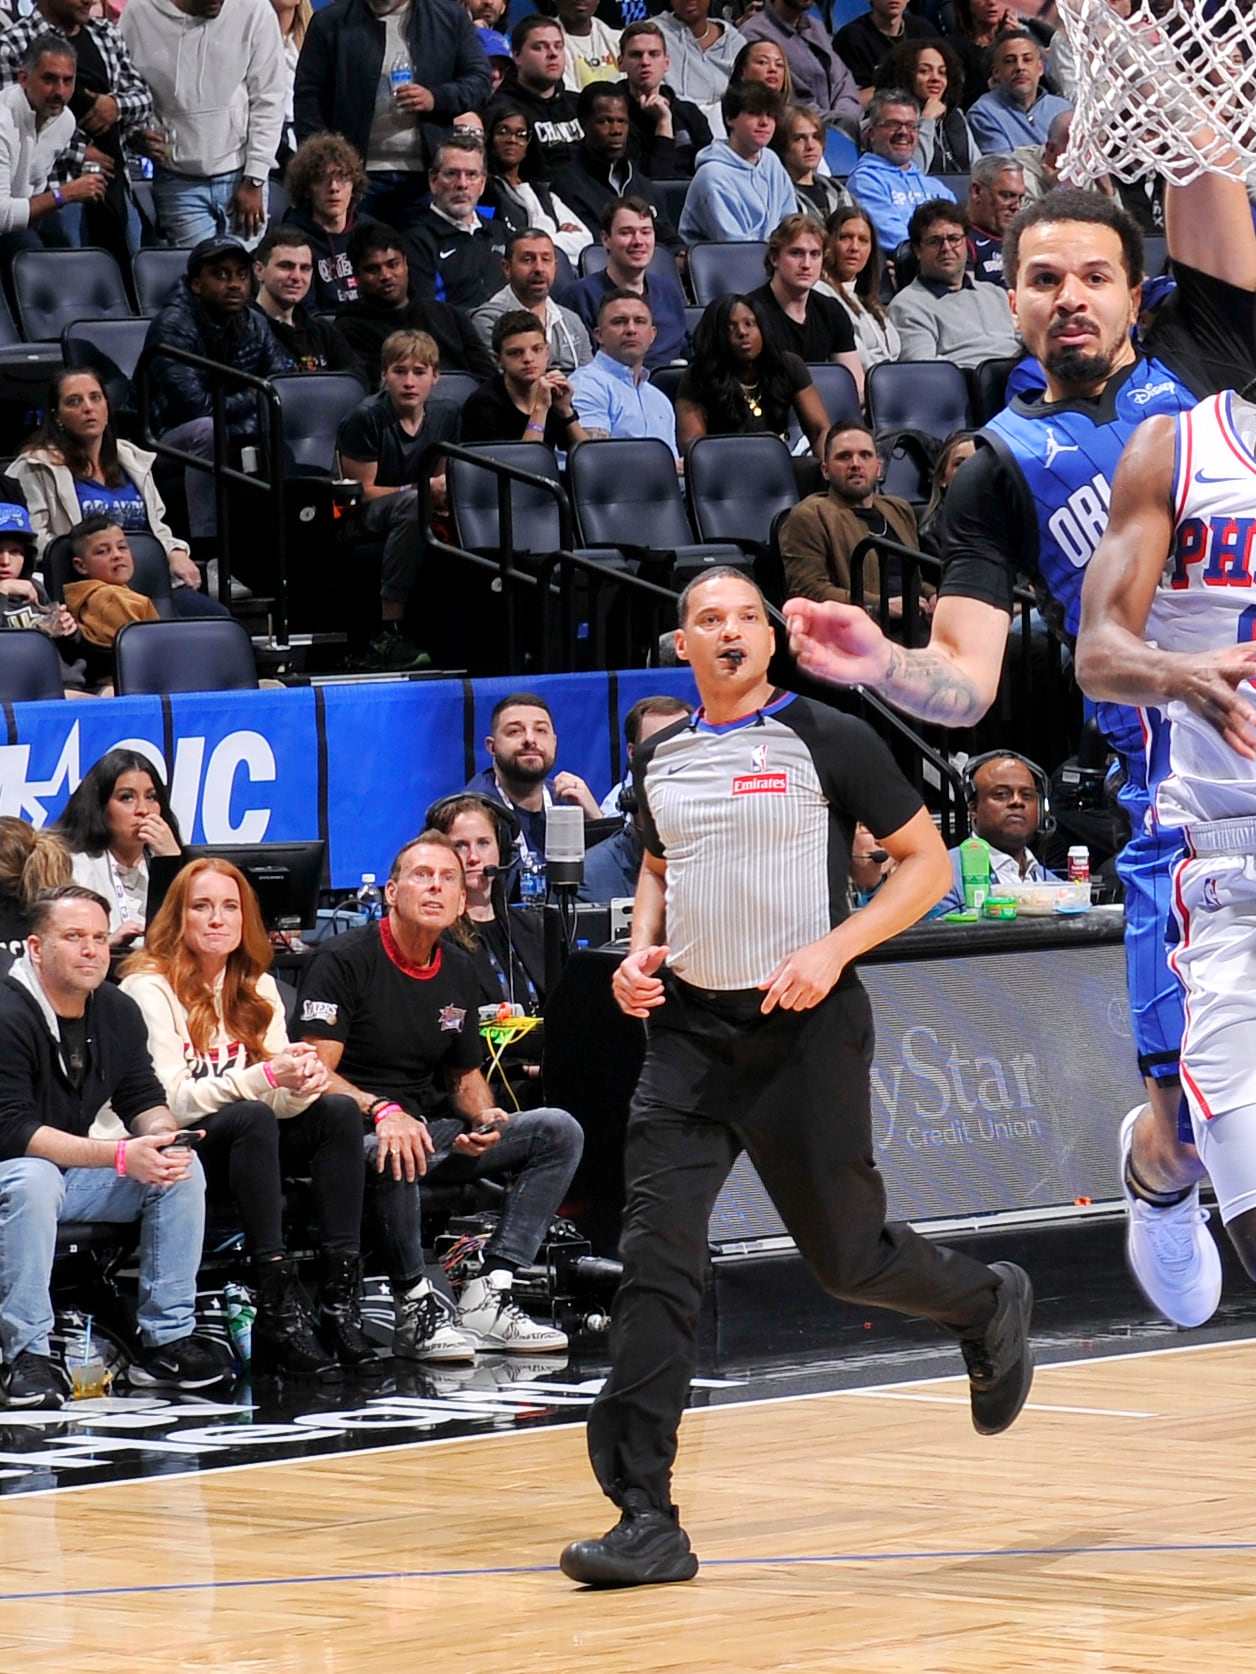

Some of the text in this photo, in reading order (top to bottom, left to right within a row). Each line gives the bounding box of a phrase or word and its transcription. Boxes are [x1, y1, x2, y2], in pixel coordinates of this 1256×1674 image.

[734, 778, 786, 793] Emirates
[870, 1026, 1037, 1150] yStar
[906, 1115, 1044, 1148] Credit Union
